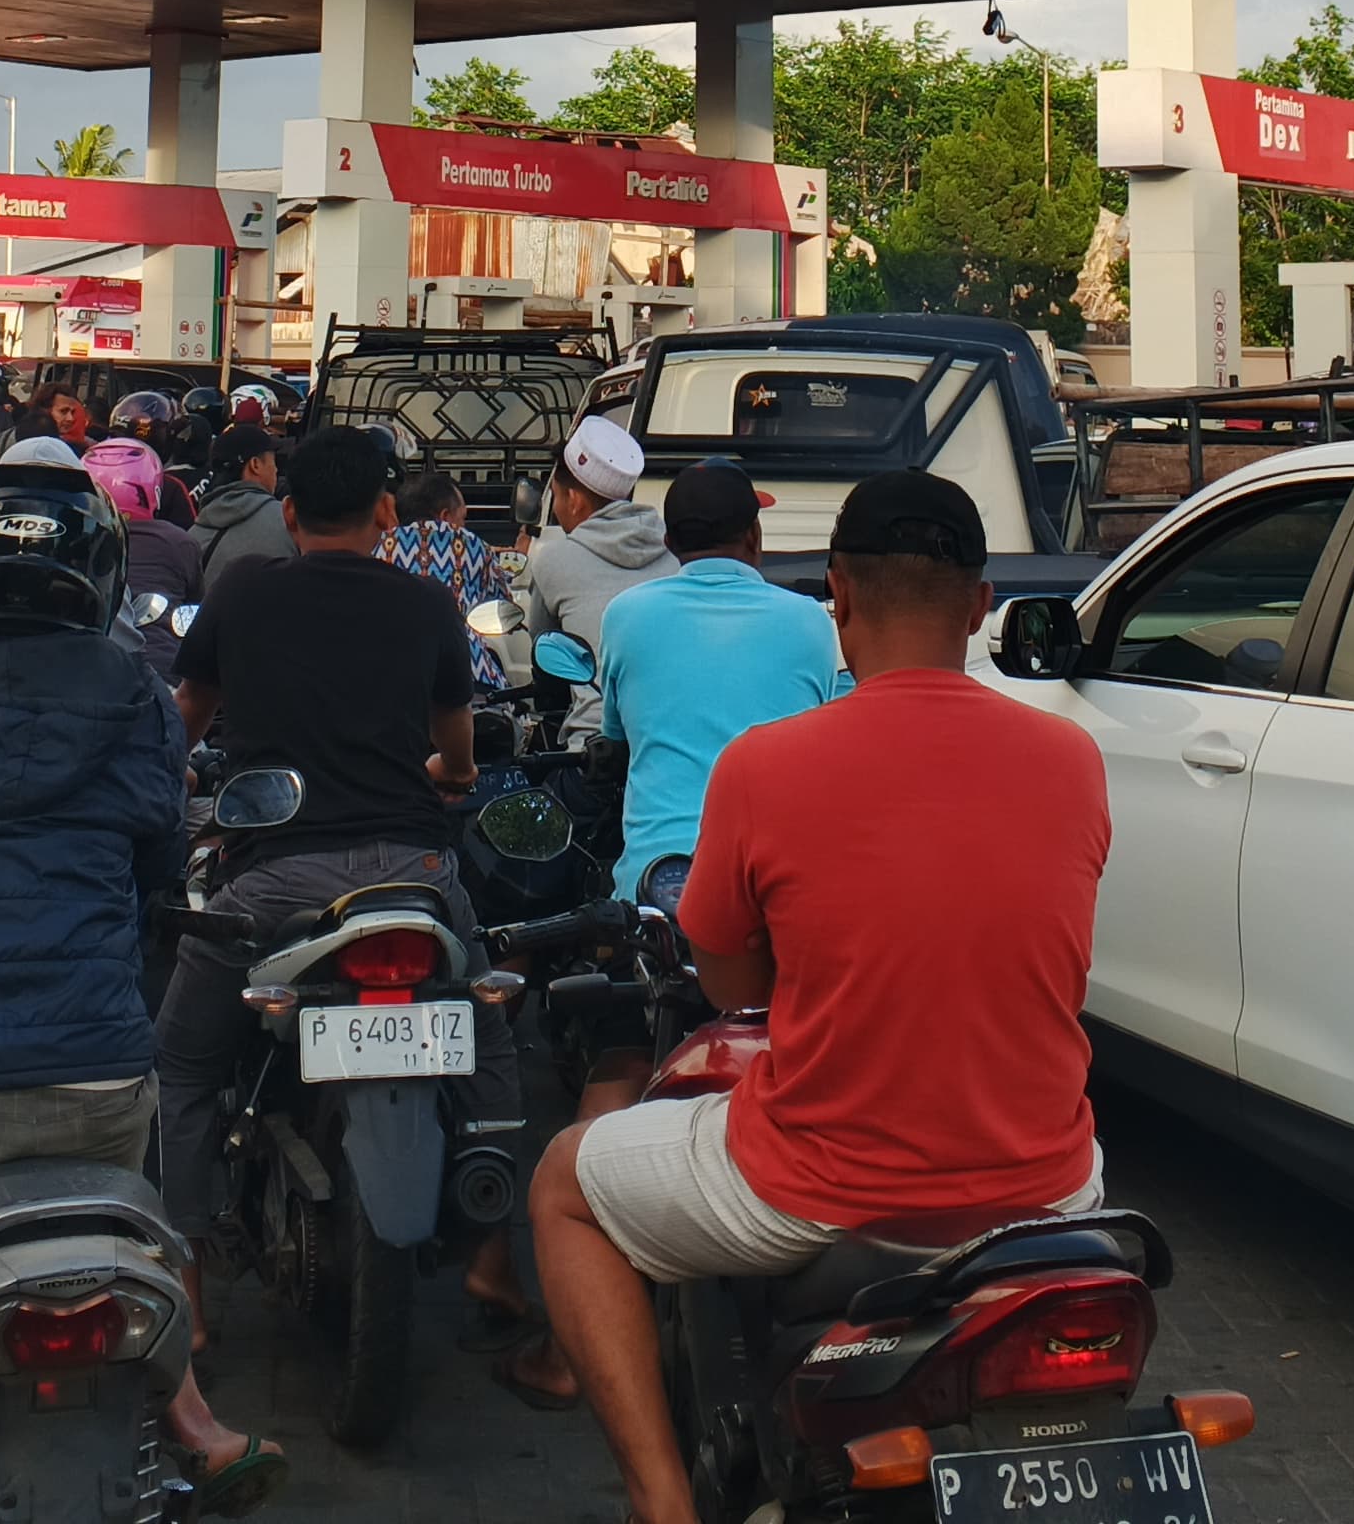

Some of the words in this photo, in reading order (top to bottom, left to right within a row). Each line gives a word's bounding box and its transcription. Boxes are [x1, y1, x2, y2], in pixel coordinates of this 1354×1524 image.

[1255, 88, 1305, 119] Pertamina
[1172, 104, 1184, 134] 3
[1259, 114, 1301, 152] Dex
[339, 147, 351, 171] 2
[441, 156, 510, 188] Pertamax
[513, 163, 552, 193] Turbo
[626, 171, 709, 203] Pertalite
[3, 519, 54, 533] MDS
[312, 1020, 327, 1046] P
[348, 1016, 414, 1043] 6403
[37, 1276, 99, 1291] HONDA
[1020, 1420, 1089, 1438] HONDA
[938, 1468, 962, 1515] P
[997, 1458, 1098, 1510] 2550
[1140, 1441, 1191, 1492] WV
